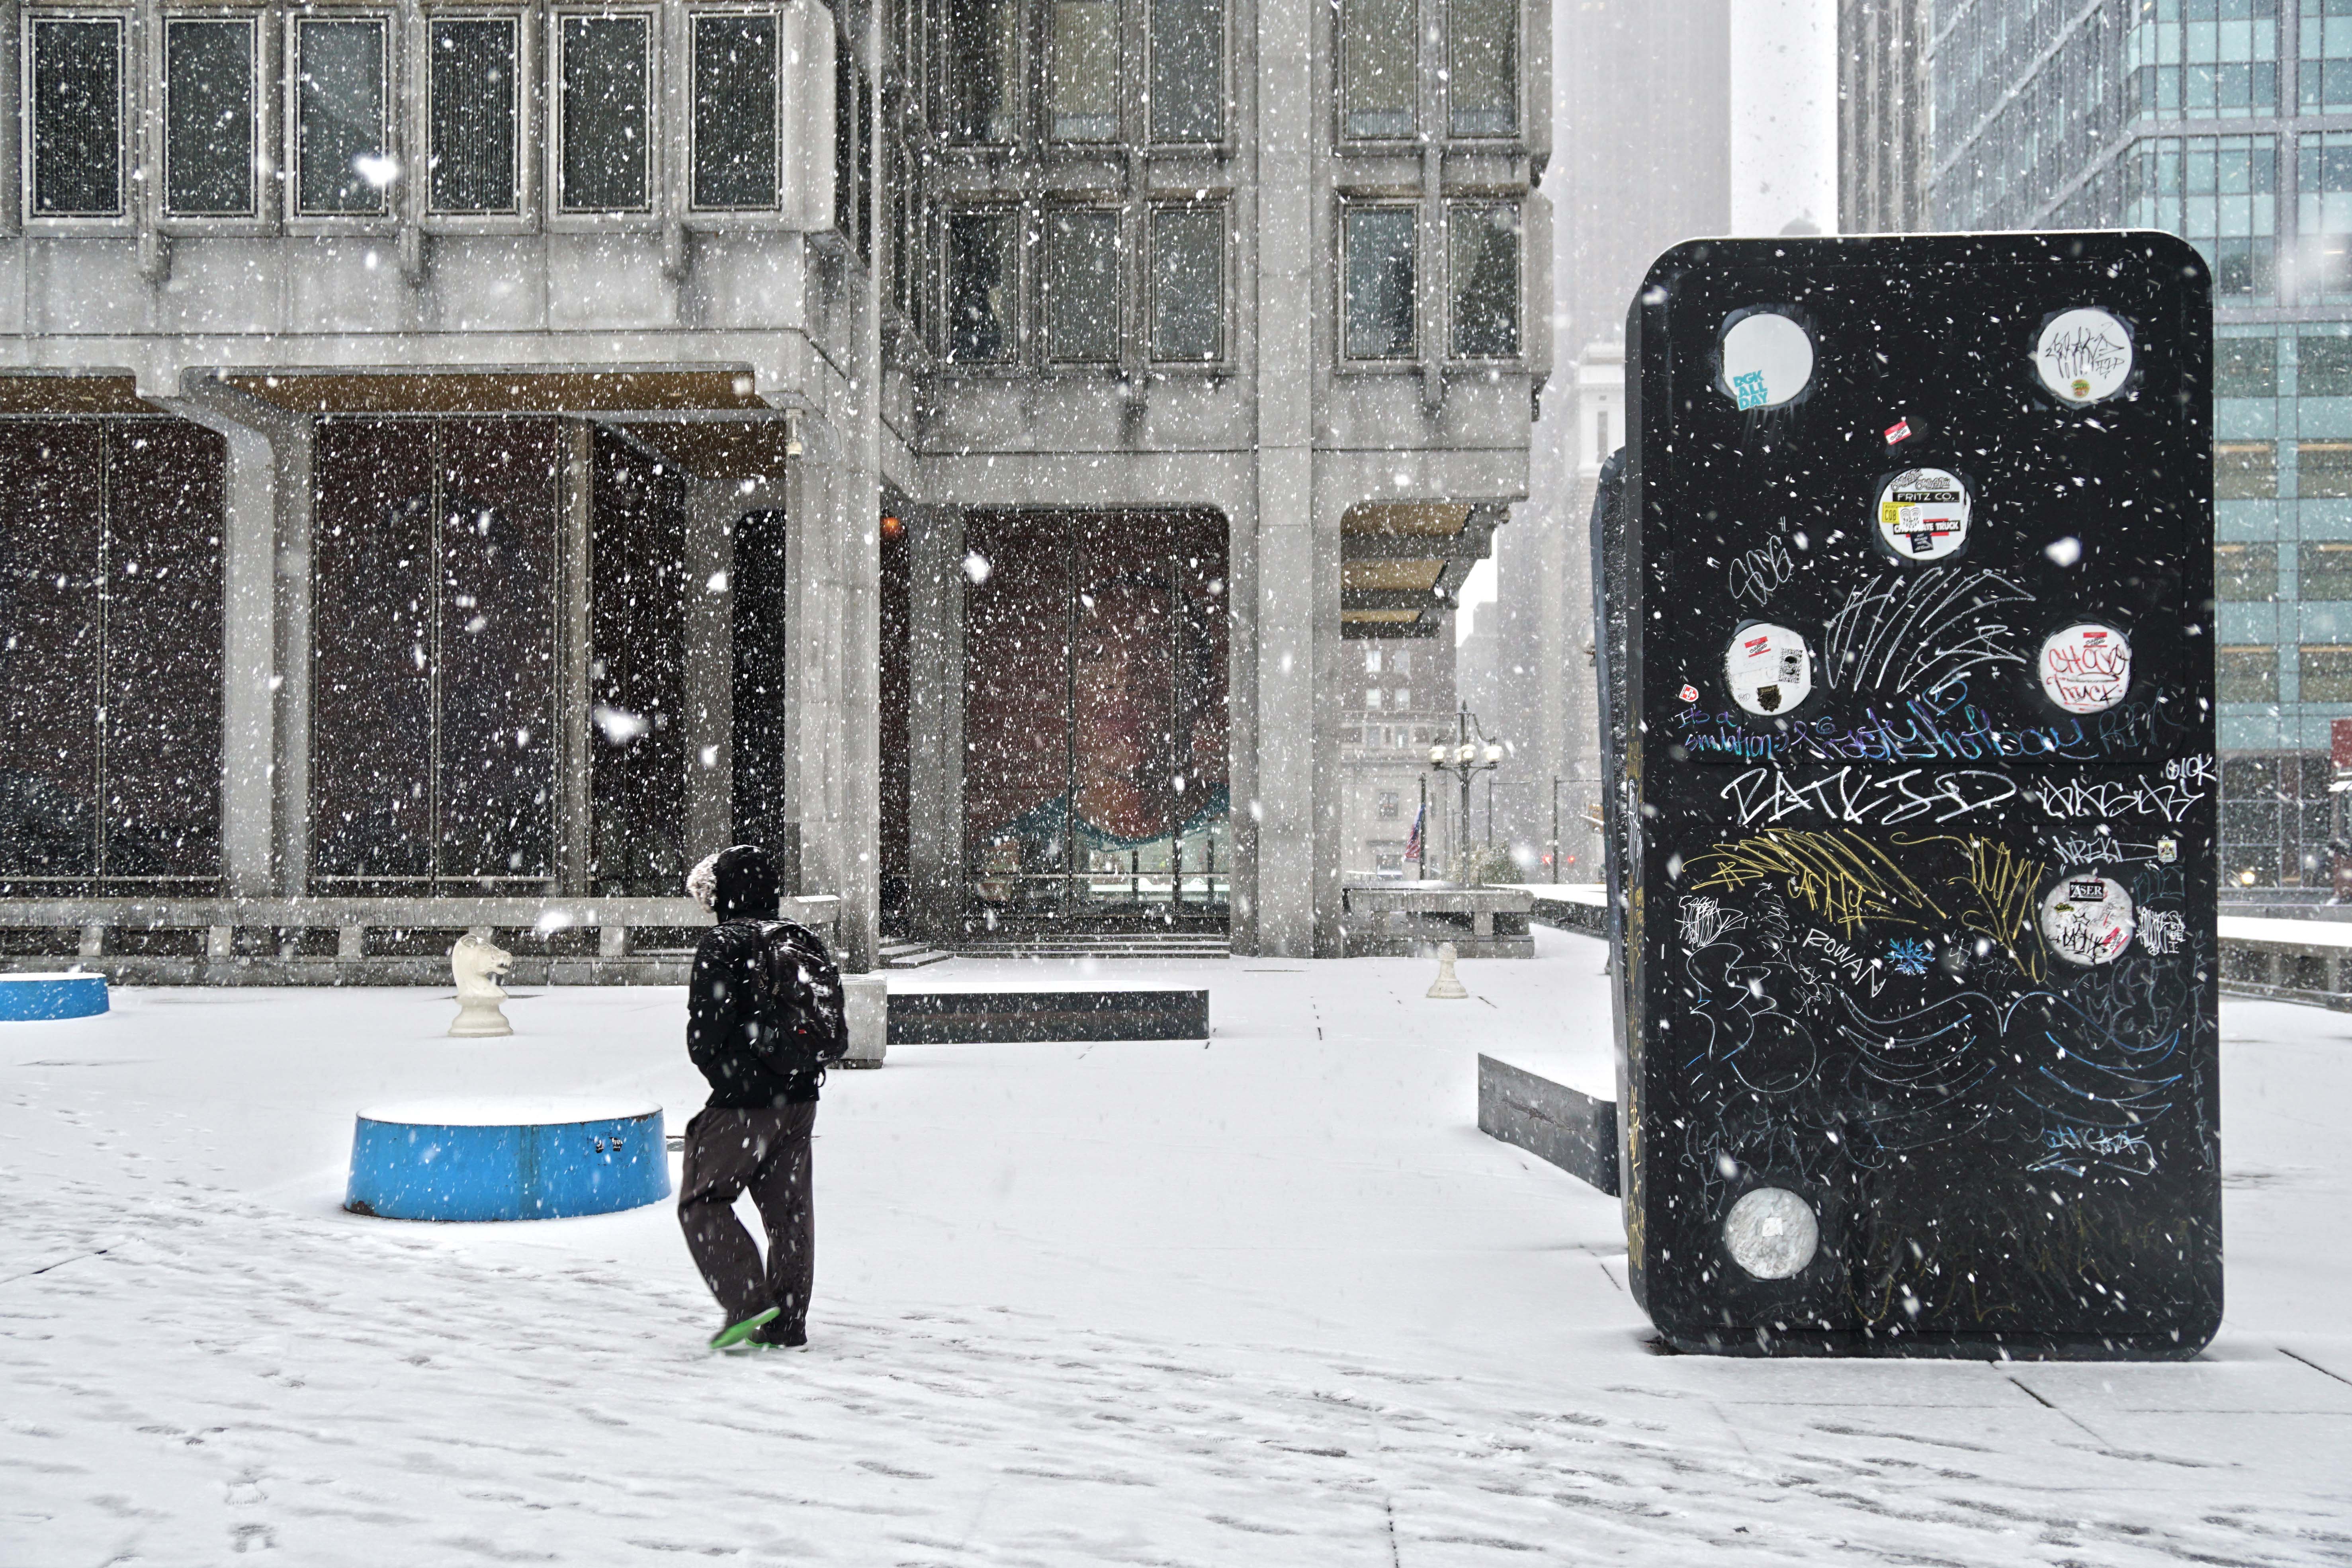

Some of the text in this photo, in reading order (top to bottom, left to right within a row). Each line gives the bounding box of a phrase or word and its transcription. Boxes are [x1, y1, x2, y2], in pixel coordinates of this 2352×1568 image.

[1733, 370, 1765, 387] DGK
[1738, 381, 1768, 398] ALL
[1738, 391, 1768, 410] DAY
[1897, 492, 1955, 501] FRITZ CO.
[1936, 521, 1959, 531] TRUCK
[1802, 928, 1887, 998] ROWAN
